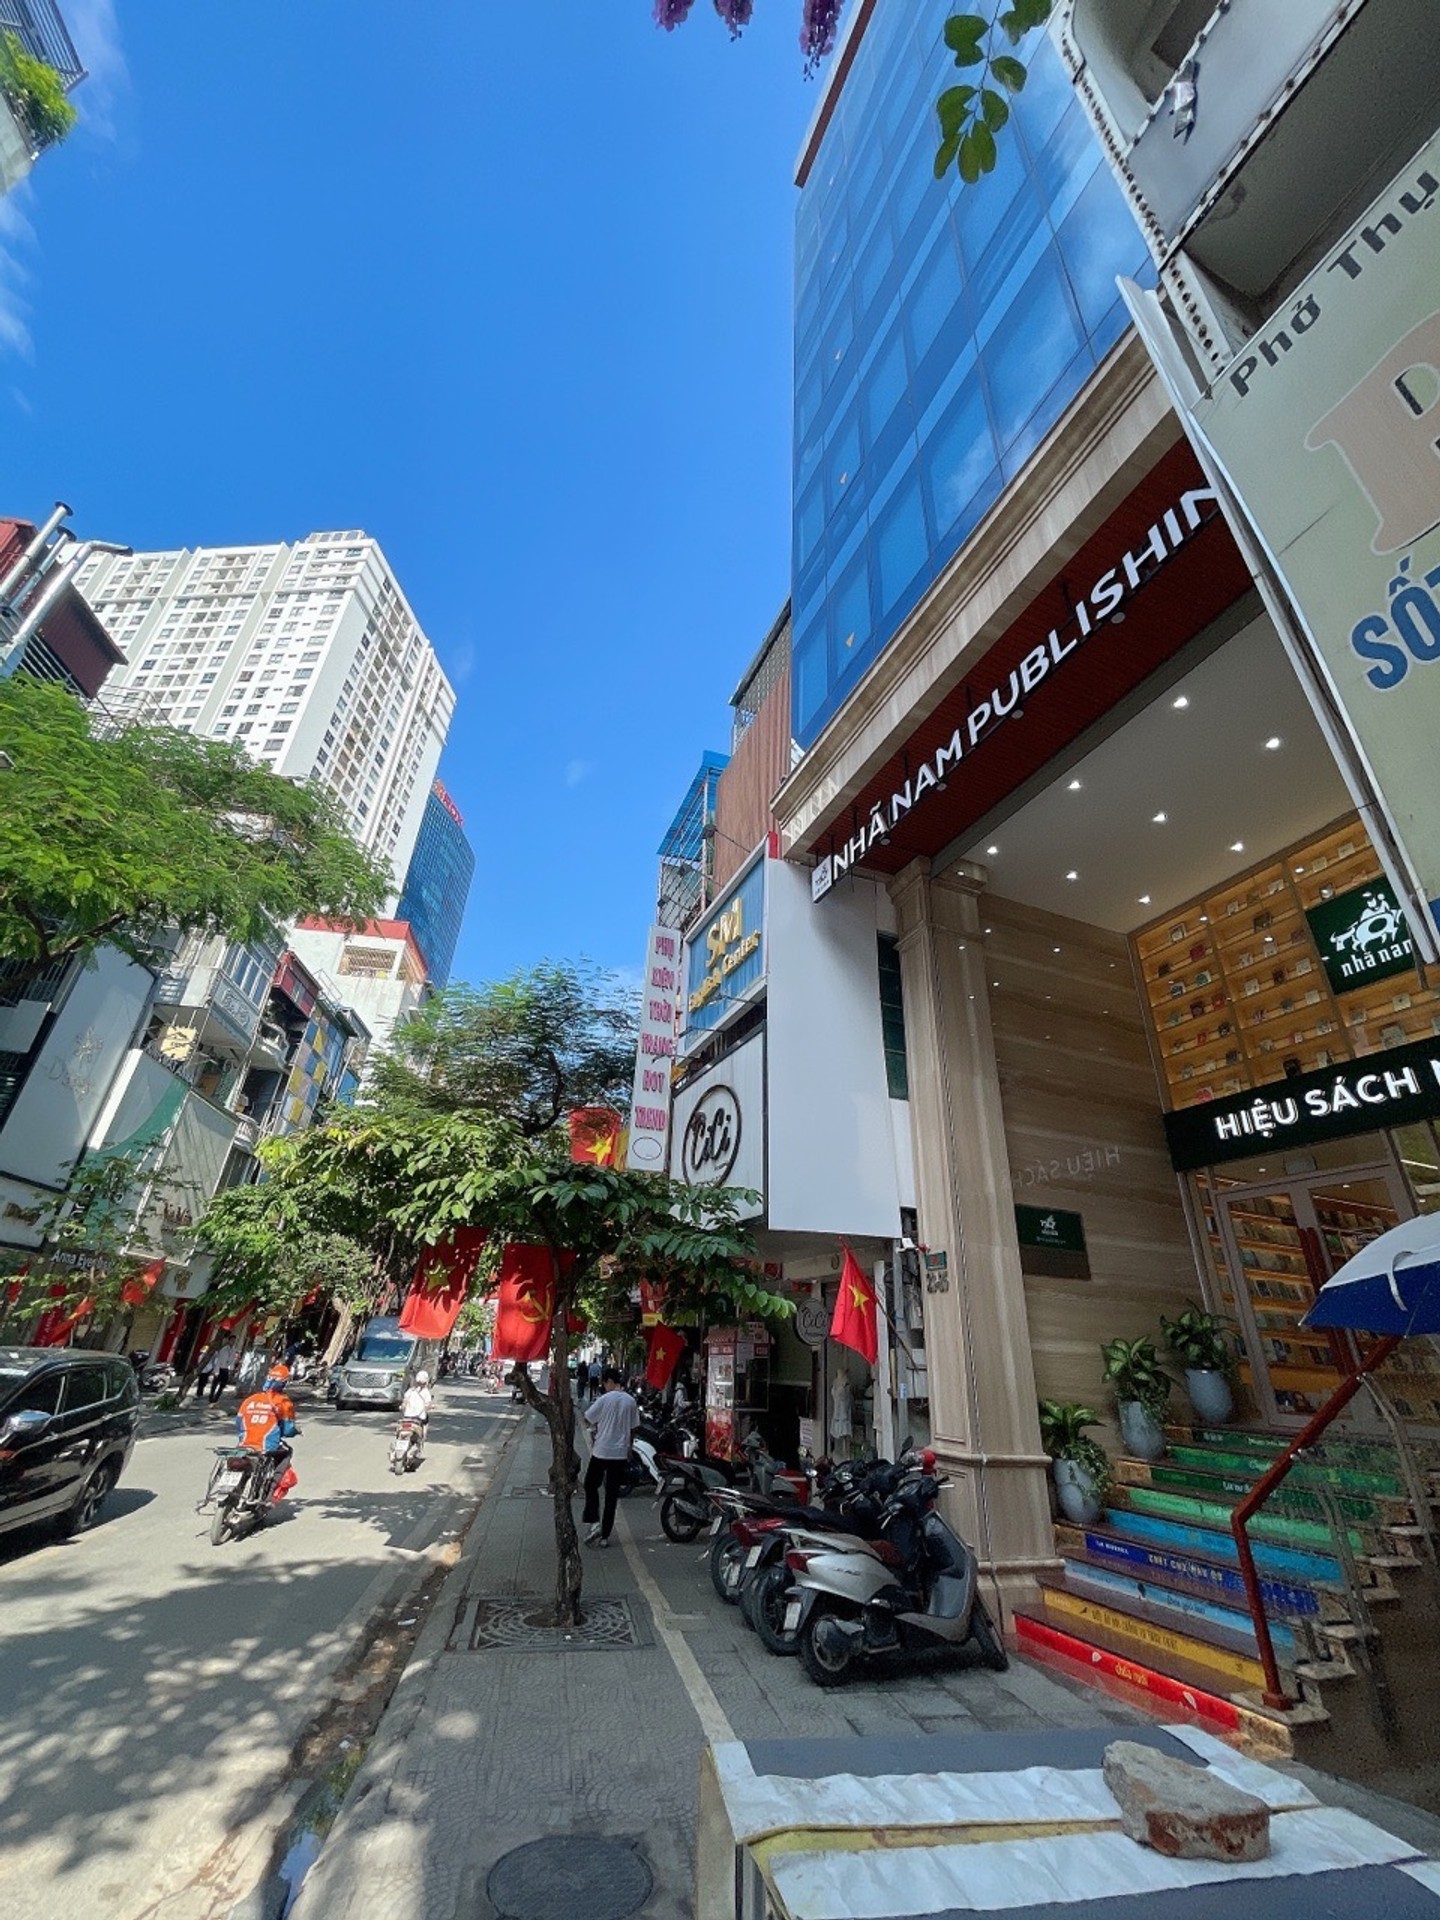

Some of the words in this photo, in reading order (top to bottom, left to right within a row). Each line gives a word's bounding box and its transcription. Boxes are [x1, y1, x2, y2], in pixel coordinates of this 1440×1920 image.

[1229, 293, 1321, 398] Phở
[833, 801, 889, 880] NHÃ
[892, 729, 963, 821] NAM
[1340, 951, 1377, 977] nhã
[642, 1070, 664, 1093] HOT
[1214, 1097, 1299, 1139] HIỆU
[1304, 1065, 1421, 1116] SÁCH
